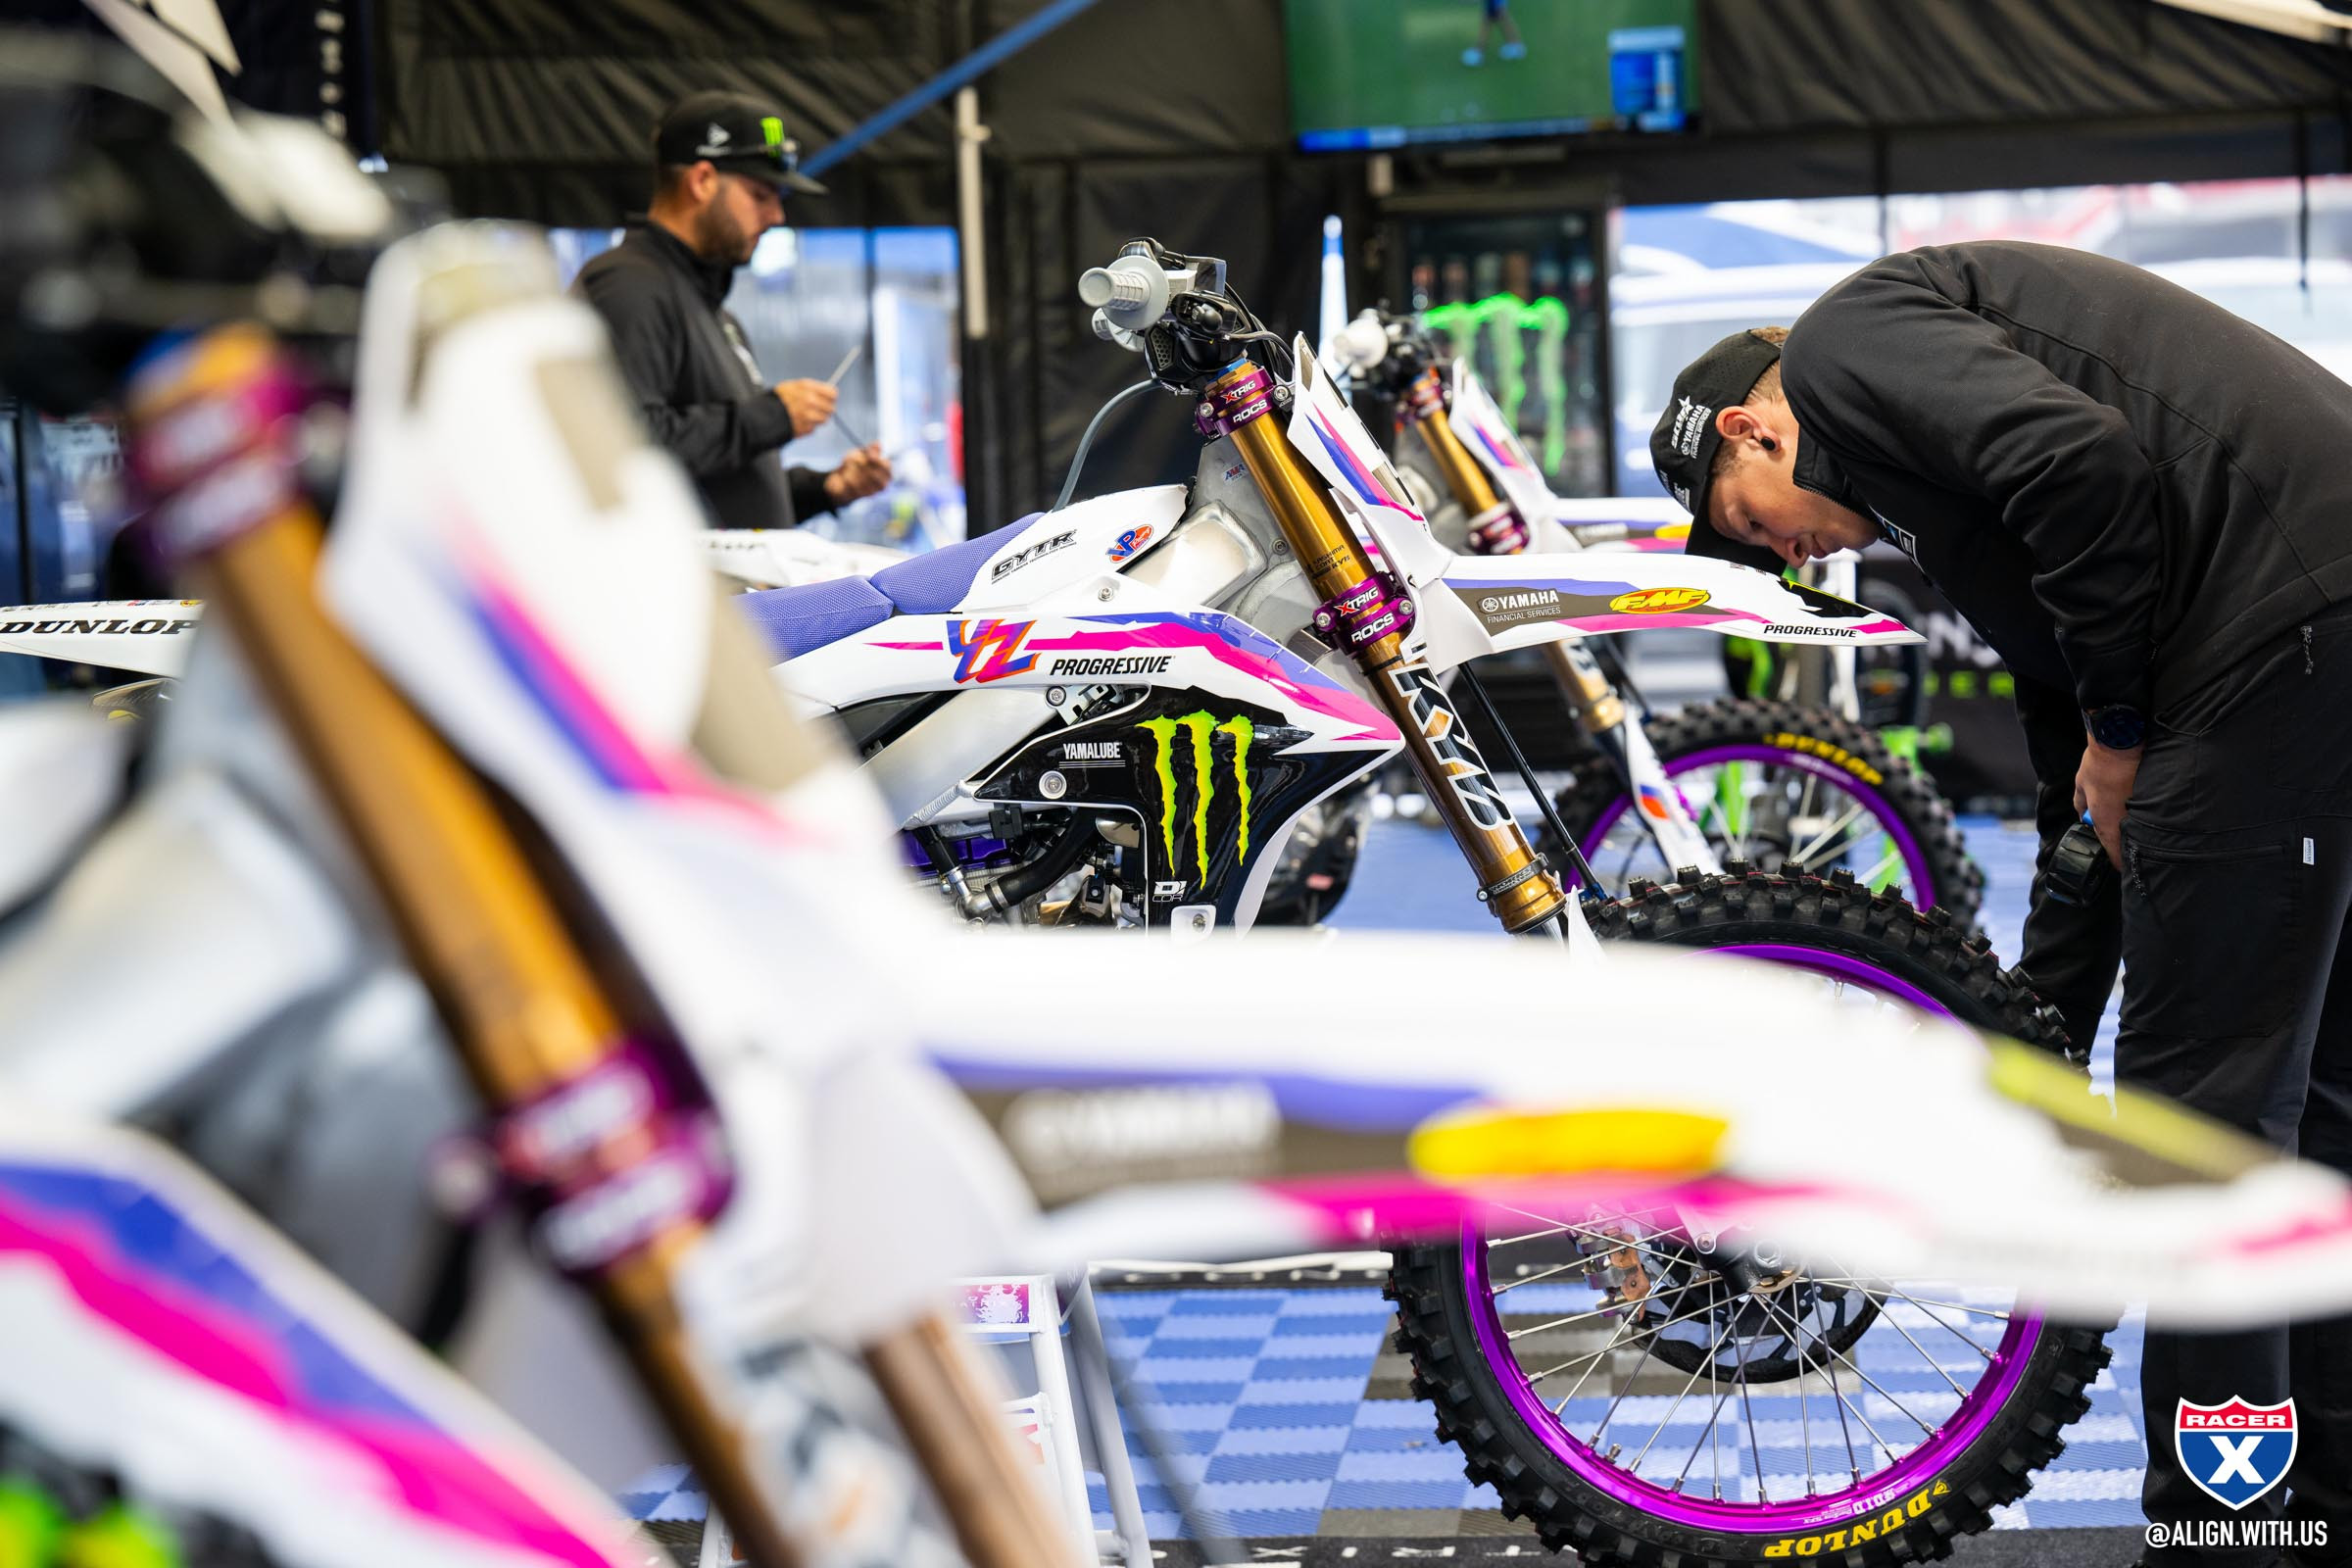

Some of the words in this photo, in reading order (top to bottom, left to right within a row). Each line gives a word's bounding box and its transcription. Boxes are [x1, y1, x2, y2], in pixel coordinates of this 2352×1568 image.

[1220, 380, 1256, 404] XTRIG
[1233, 399, 1267, 422] ROCS
[1684, 405, 1705, 442] YAMAHA
[992, 530, 1077, 580] GYTR
[1334, 587, 1379, 617] XTRIG
[1498, 590, 1559, 609] YAMAHA
[1612, 589, 1708, 612] FMF
[0, 619, 202, 635] DUNLOP
[1351, 612, 1395, 642] ROCS
[1487, 612, 1526, 624] FINANCIAL
[1527, 607, 1561, 619] SERVICES
[1764, 624, 1857, 638] PROGRESSIVE
[1050, 656, 1172, 676] PROGRESSIVE
[1063, 742, 1121, 760] YAMALUBE
[1387, 662, 1514, 831] KYB
[1764, 1489, 1932, 1557] DUNLOP
